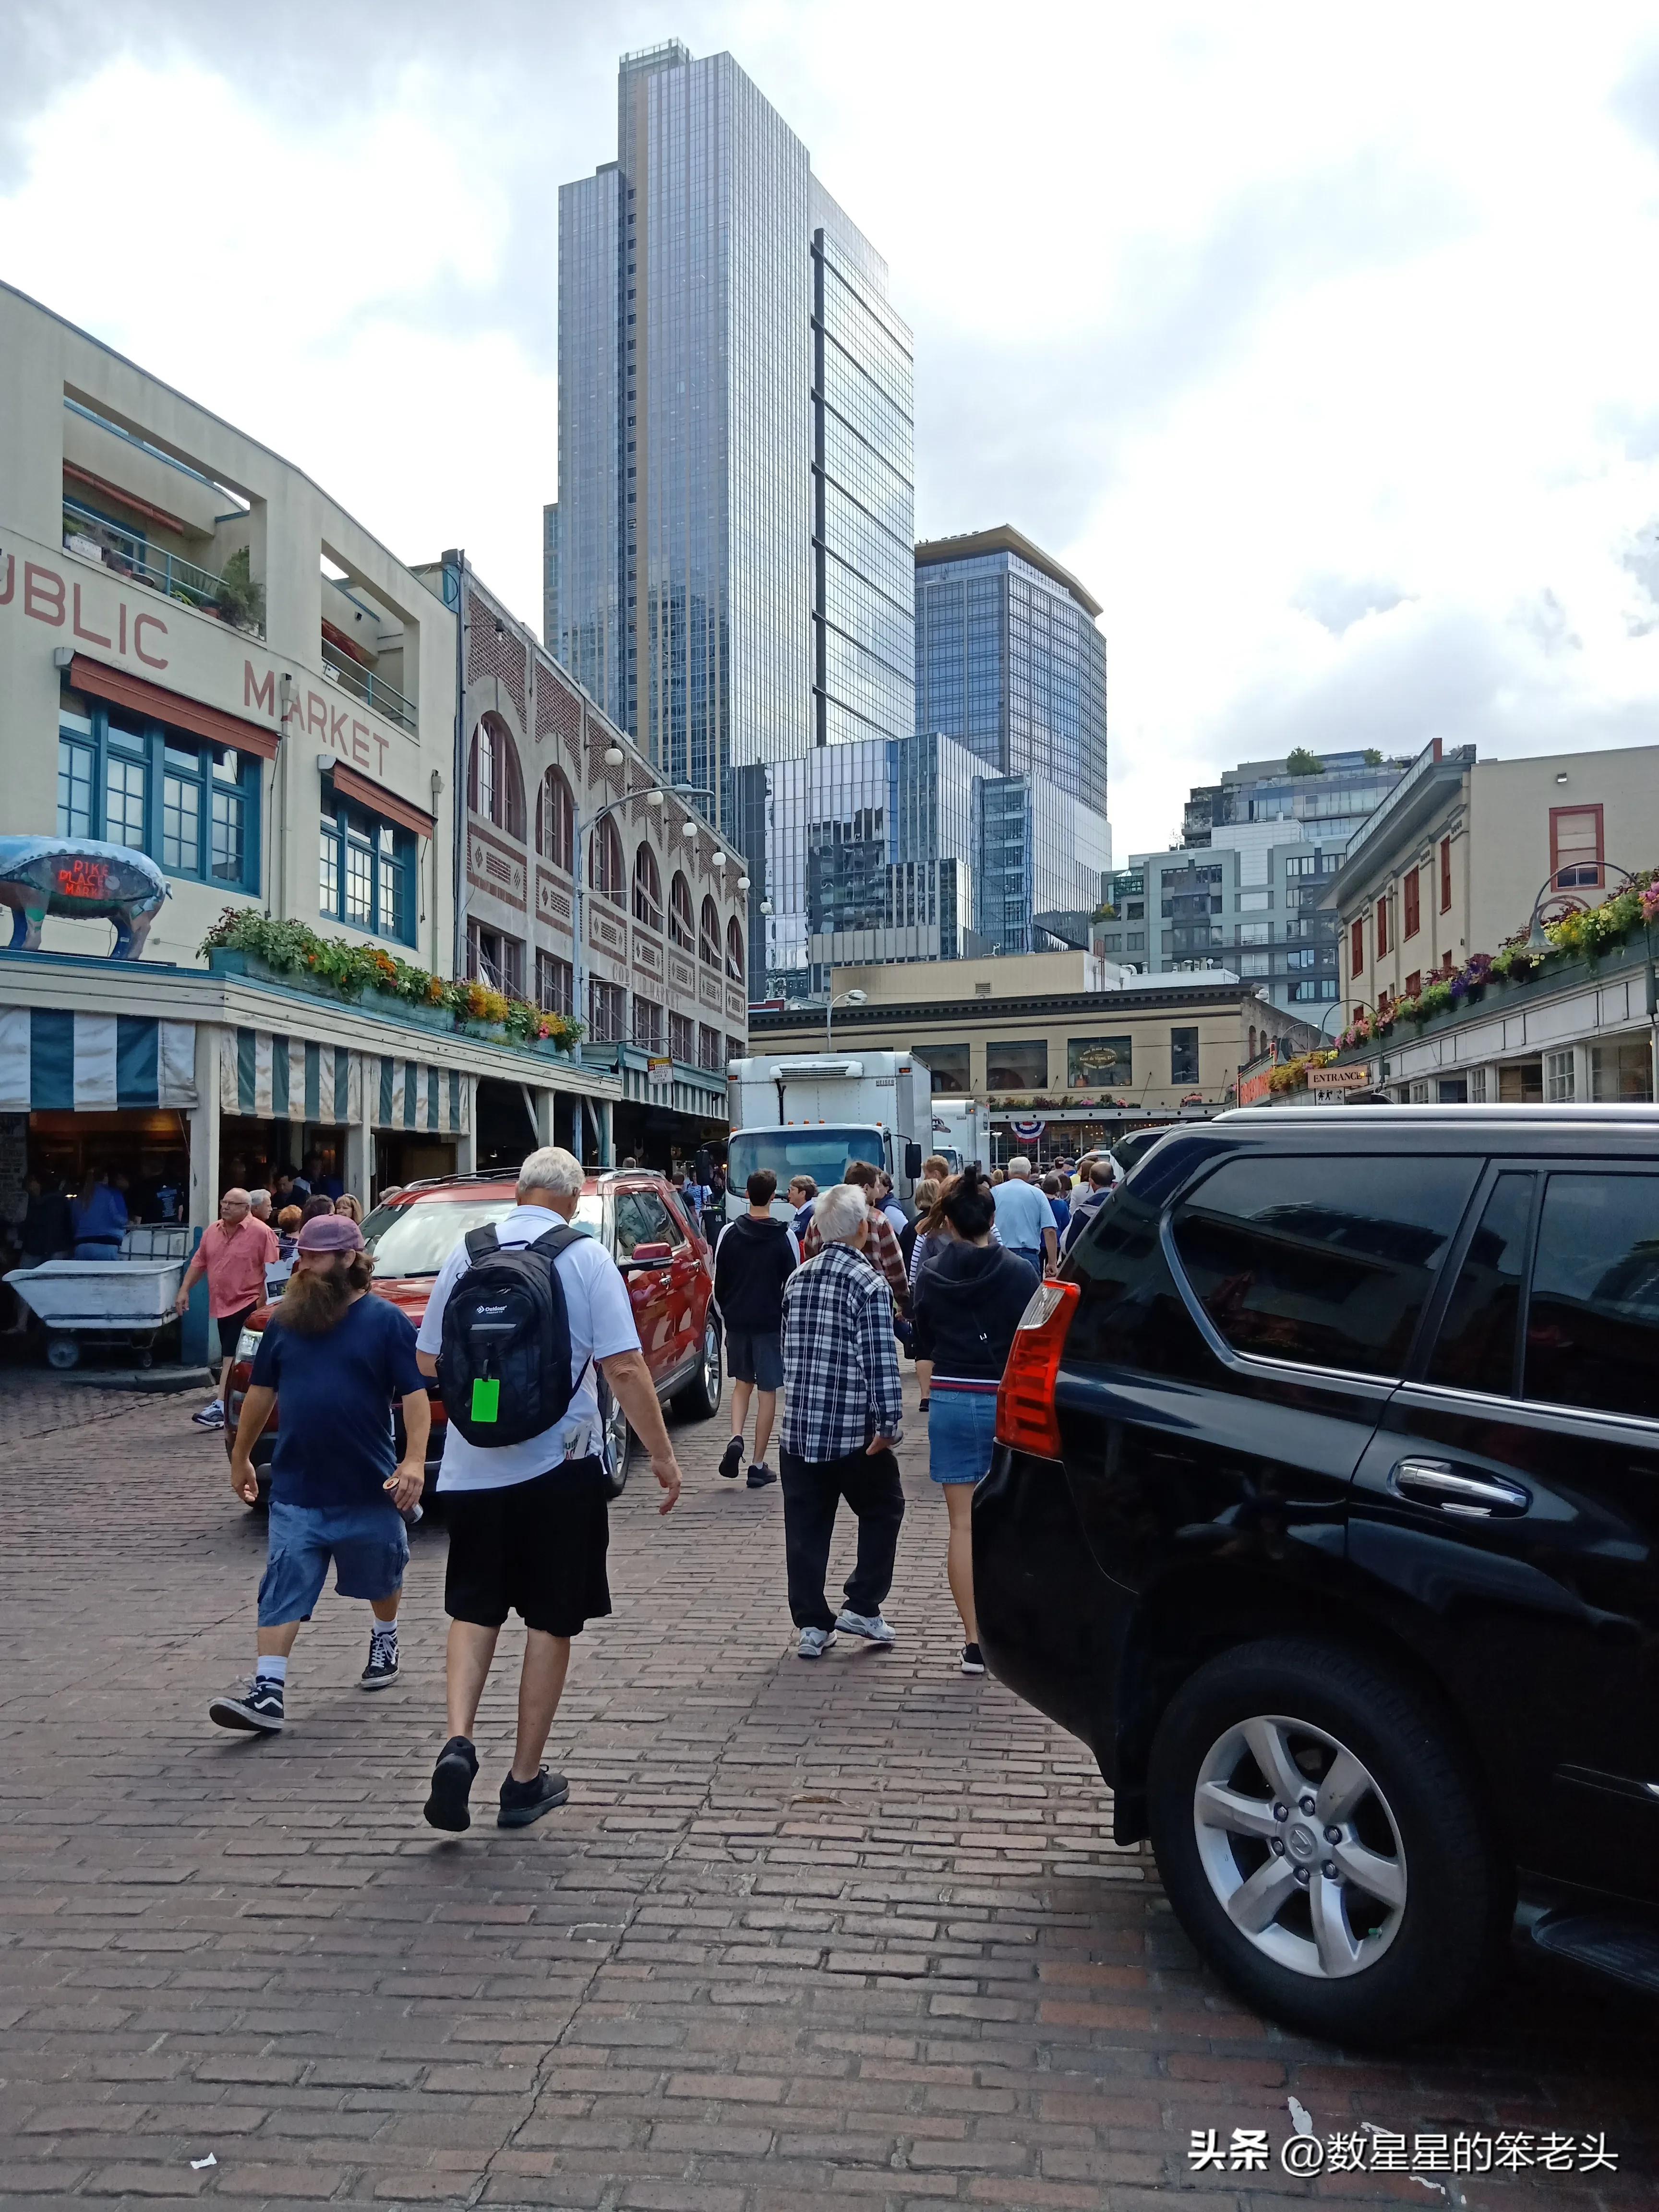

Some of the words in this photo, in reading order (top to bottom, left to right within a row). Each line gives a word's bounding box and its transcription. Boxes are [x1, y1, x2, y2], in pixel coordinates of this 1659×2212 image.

[244, 660, 390, 777] MARKET
[74, 860, 109, 876] PIKE
[59, 870, 104, 887] PLACE
[1313, 1071, 1362, 1082] ENTRANCE
